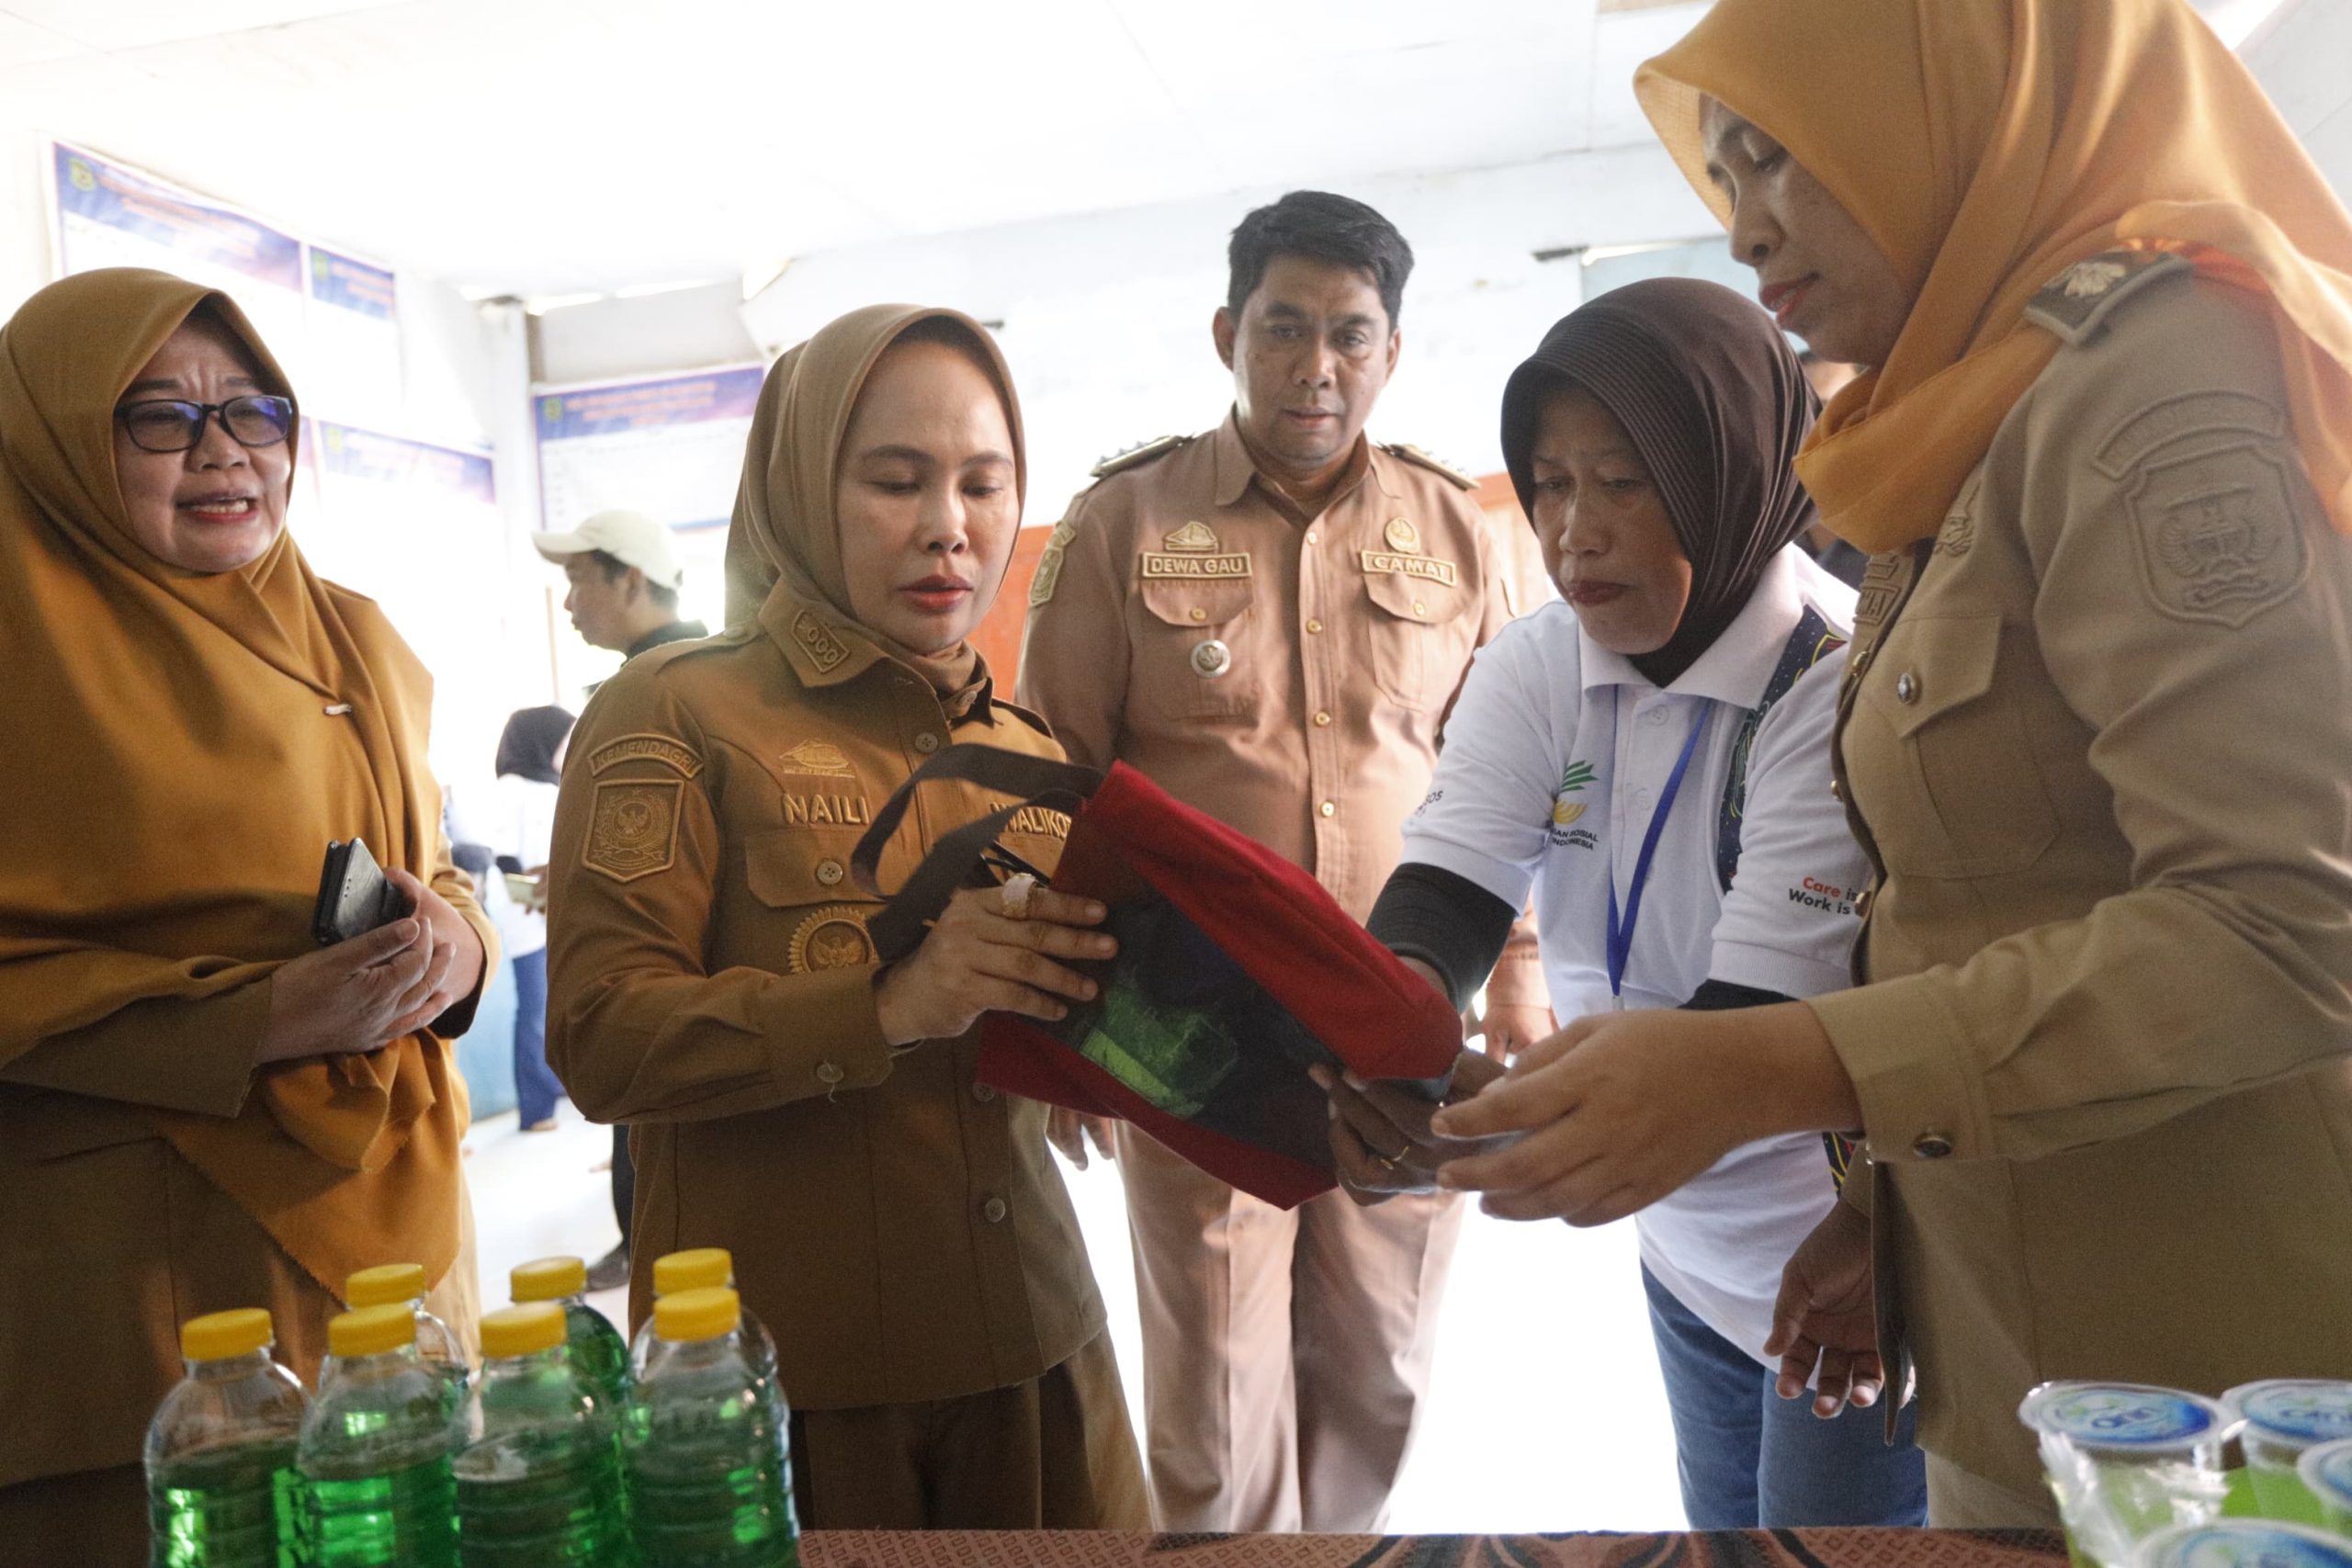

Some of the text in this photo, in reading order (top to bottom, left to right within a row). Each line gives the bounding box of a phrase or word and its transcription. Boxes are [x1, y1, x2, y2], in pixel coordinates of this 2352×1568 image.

[1150, 558, 1243, 573] DEWA GAU
[1374, 556, 1449, 581] CAMAT
[595, 739, 696, 773] KEMENDAGRI
[783, 794, 869, 825] NAILI
[1803, 875, 1857, 901] Care is
[1788, 888, 1851, 916] Work is
